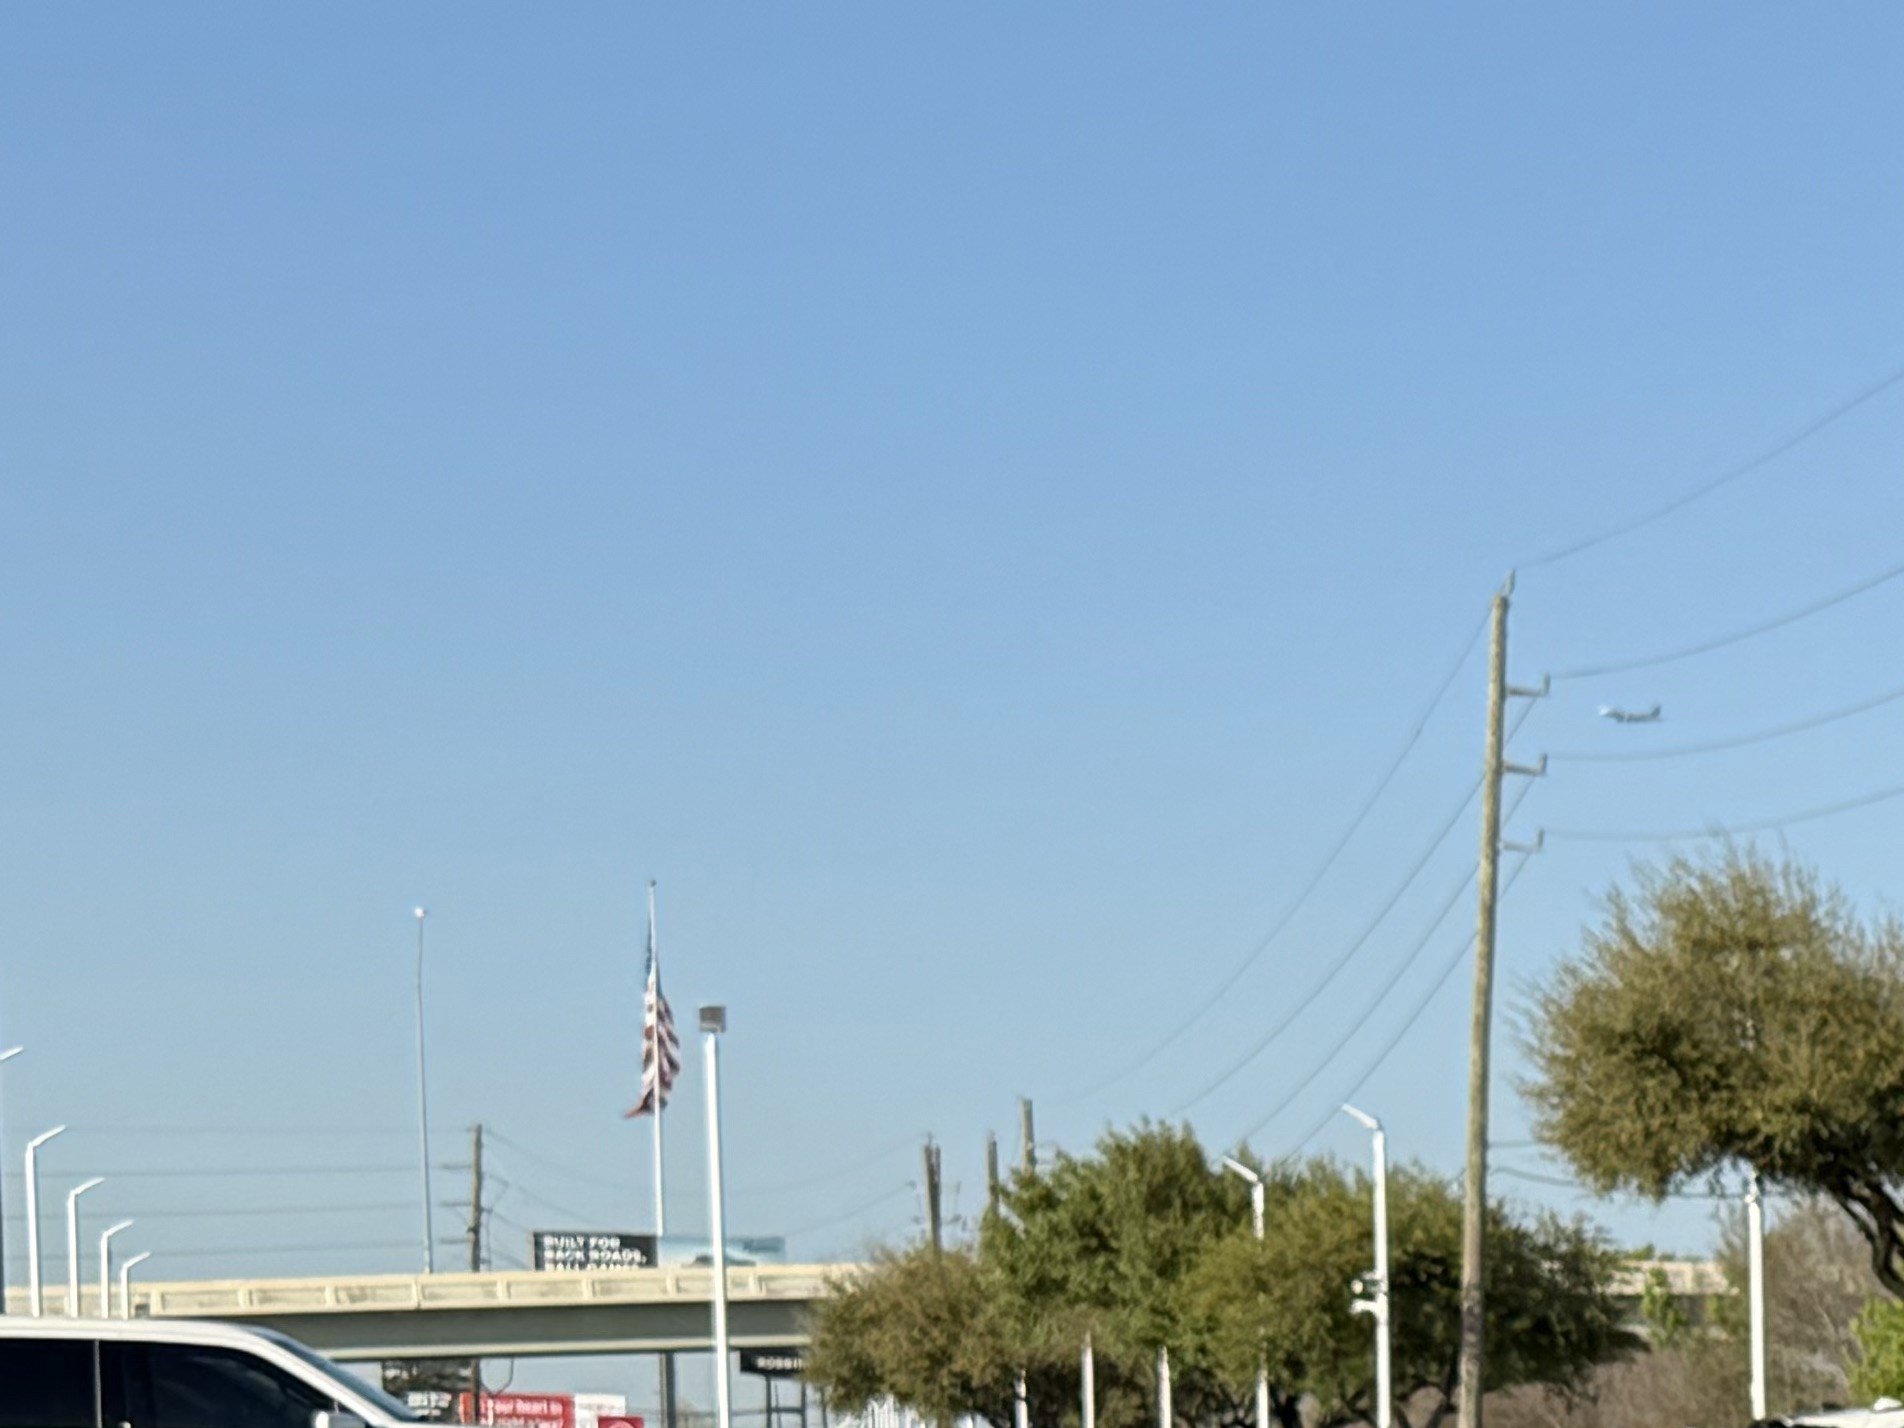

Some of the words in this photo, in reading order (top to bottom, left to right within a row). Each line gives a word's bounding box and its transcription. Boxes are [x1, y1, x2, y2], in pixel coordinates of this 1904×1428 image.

[543, 1235, 585, 1249] BUILT
[589, 1236, 621, 1249] FOR
[543, 1249, 586, 1262] BACK
[589, 1249, 648, 1264] ROADS,
